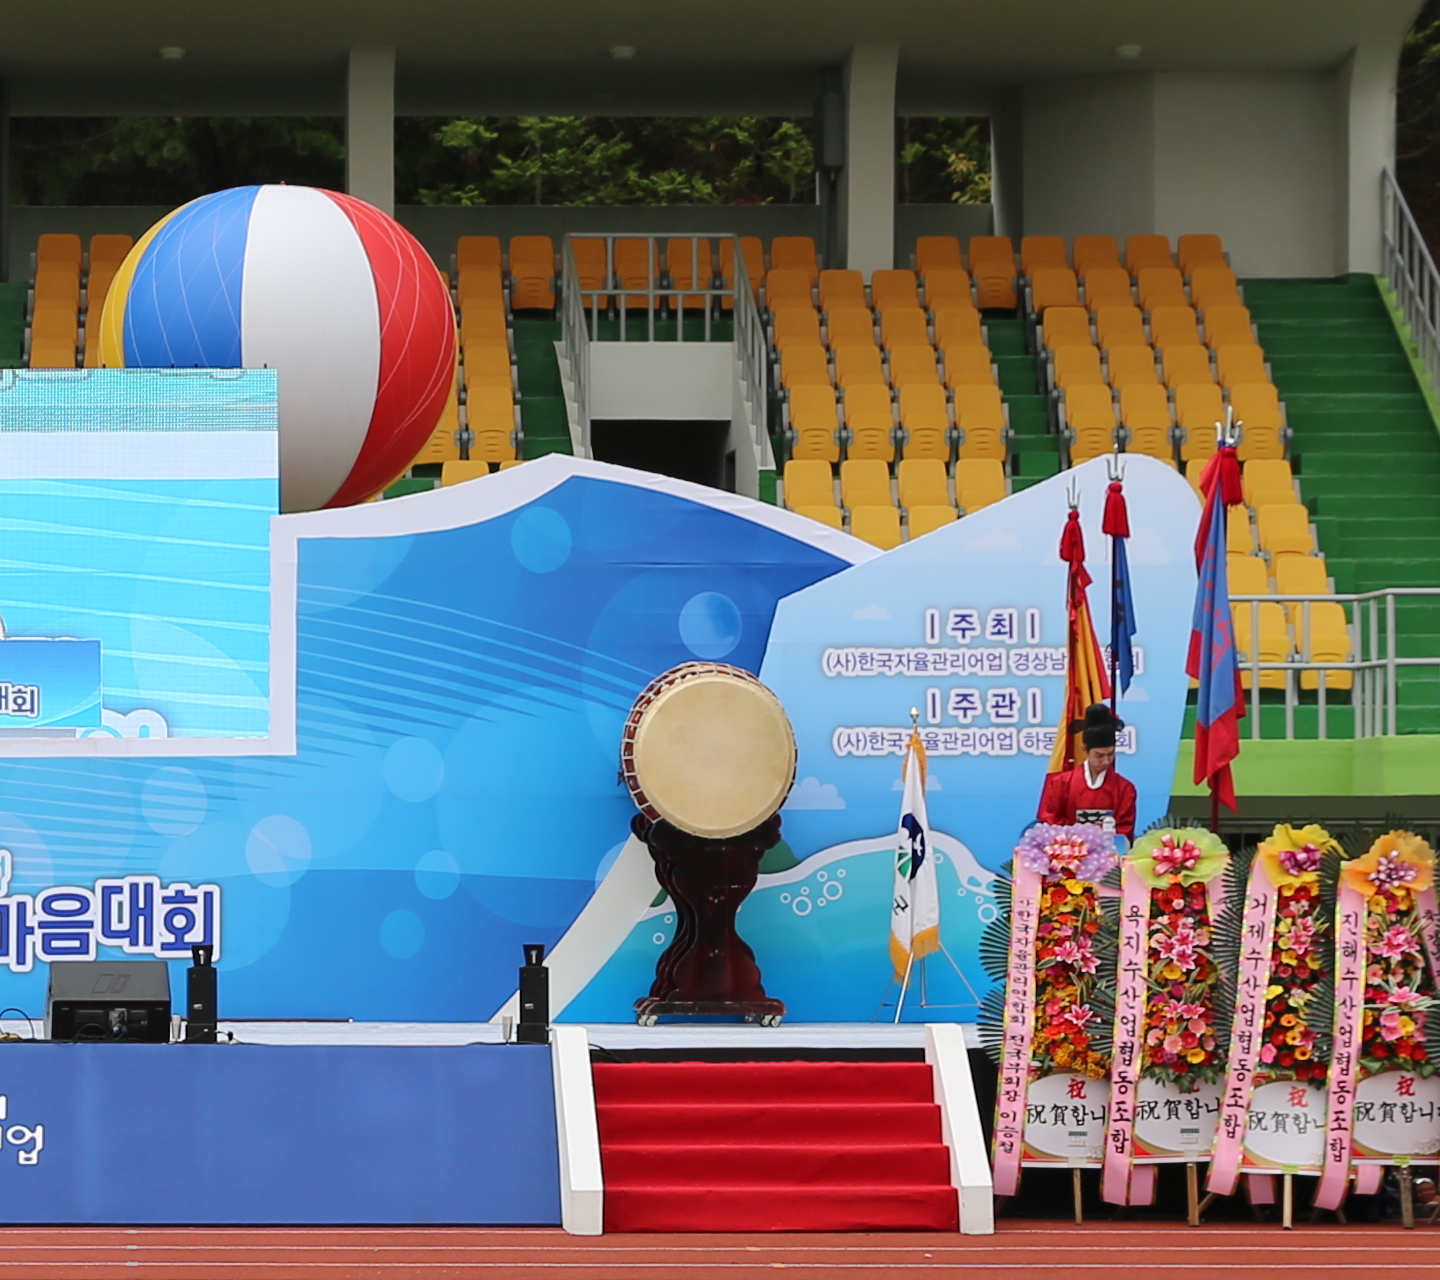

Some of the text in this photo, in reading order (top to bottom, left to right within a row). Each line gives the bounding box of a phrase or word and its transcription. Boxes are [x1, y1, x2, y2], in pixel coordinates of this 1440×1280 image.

[826, 651, 1067, 672] (사)한국자율관리어업 경상남
[1223, 892, 1270, 1140] 거제수산업협동조합
[1110, 904, 1145, 1155] 욕지수산업협동조합
[1329, 910, 1360, 1163] 진해수산업협동조합
[1066, 1078, 1087, 1100] 祝
[1286, 1086, 1309, 1108] 祝
[1395, 1075, 1416, 1097] 祝
[1027, 1103, 1106, 1127] 祝賀합니
[1137, 1099, 1221, 1121] 祝賀합니
